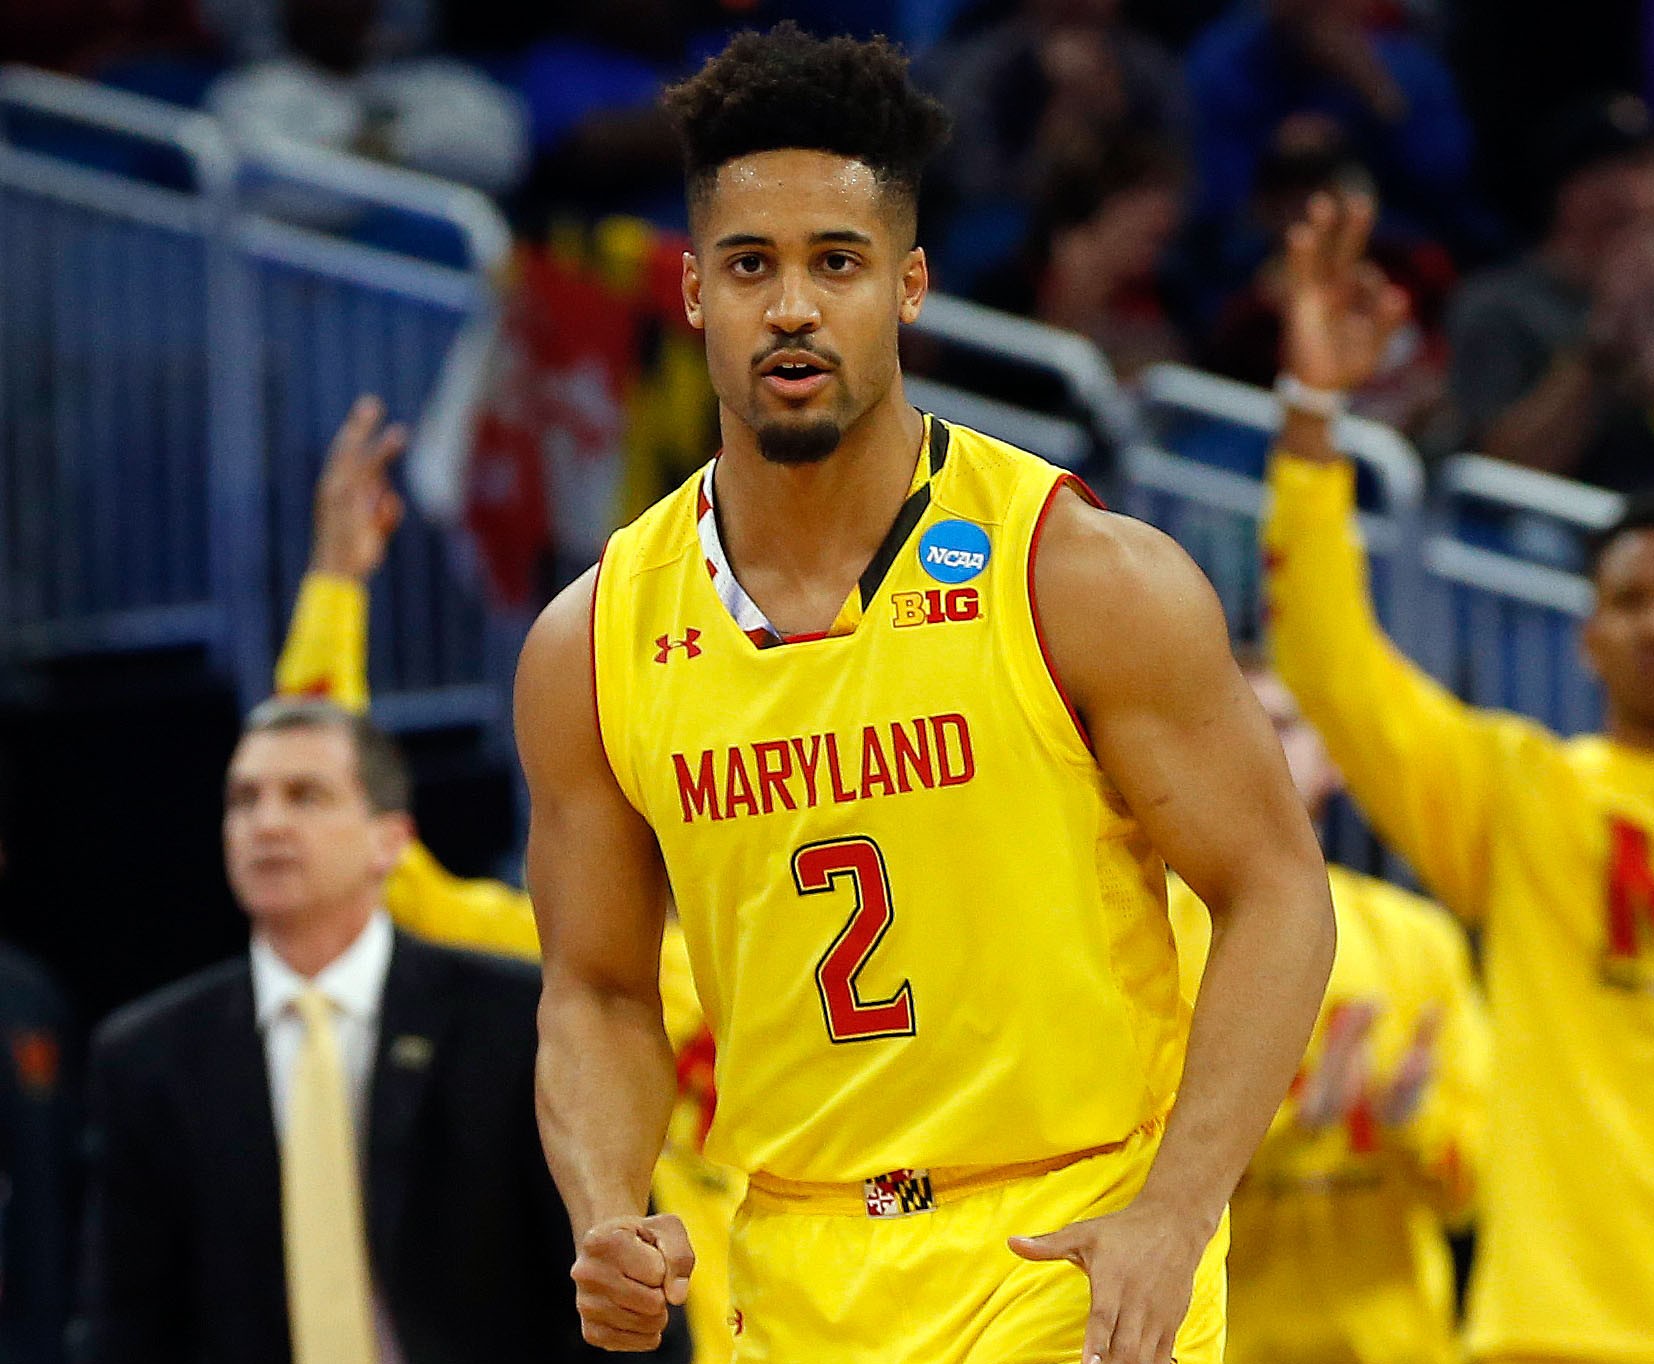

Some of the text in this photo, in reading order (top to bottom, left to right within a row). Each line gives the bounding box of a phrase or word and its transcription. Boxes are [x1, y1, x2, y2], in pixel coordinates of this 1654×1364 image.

[926, 545, 985, 571] NCAA
[671, 712, 976, 824] MARYLAND
[790, 833, 917, 1045] 2
